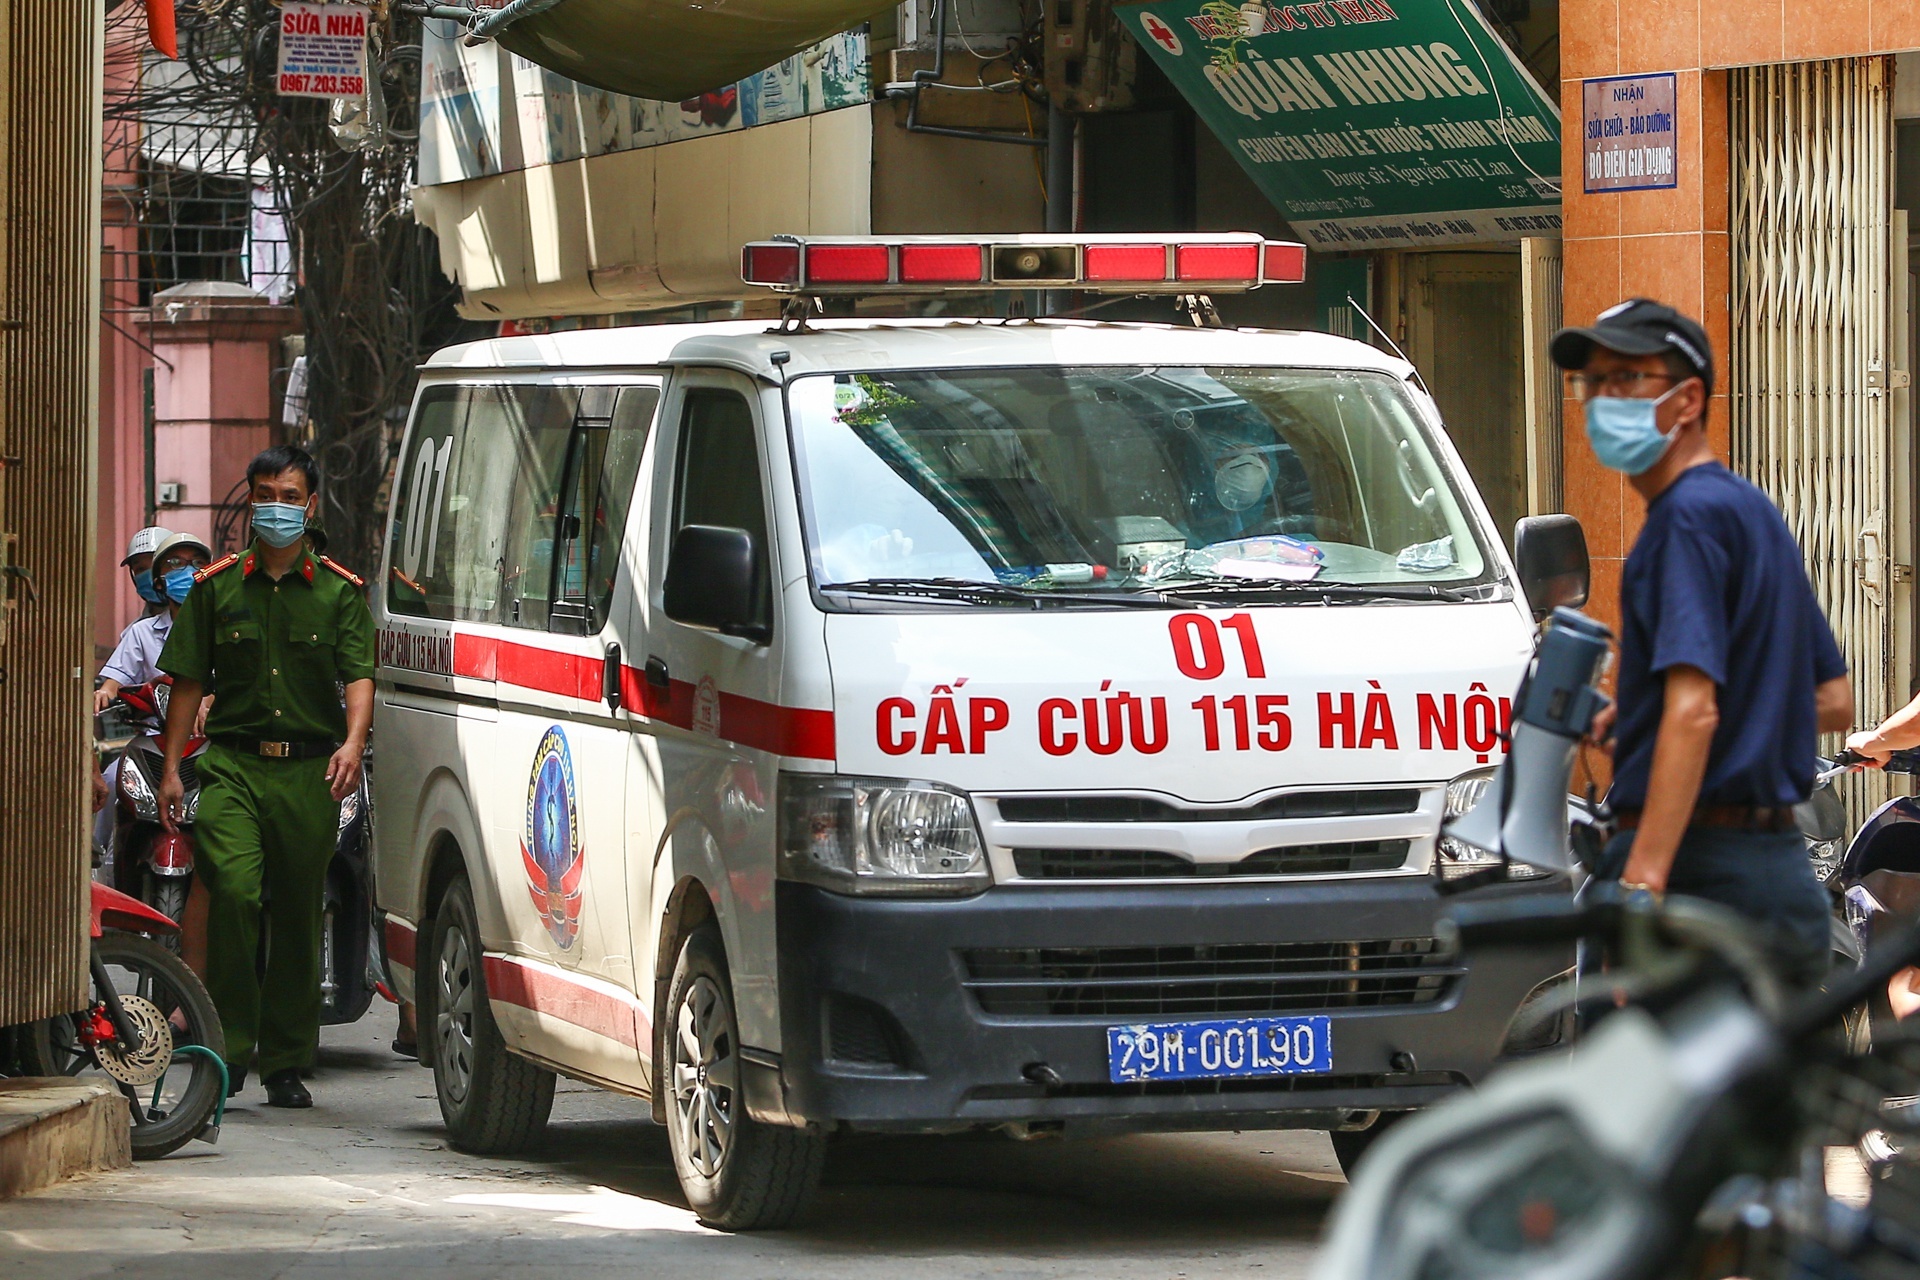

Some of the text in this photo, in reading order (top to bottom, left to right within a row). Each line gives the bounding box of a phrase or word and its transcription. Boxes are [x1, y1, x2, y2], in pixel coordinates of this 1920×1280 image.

[283, 7, 365, 36] SỬA NHÀ
[280, 74, 363, 95] 0967.203.558
[1313, 42, 1489, 106] NHUNG
[1613, 84, 1644, 104] NHẬN
[1238, 106, 1554, 163] CHUYÊN BÁN LẺ THUỐC THÀNH PHẨM
[1588, 112, 1602, 139] SỬA
[1604, 113, 1623, 138] CHỮA
[1630, 108, 1644, 135] BẢO
[1646, 109, 1671, 133] DƯỠNG
[1322, 168, 1370, 190] Dược
[1384, 157, 1450, 187] Nguyễn
[1442, 158, 1485, 182] Thị
[1473, 158, 1514, 176] Lan
[1604, 144, 1626, 184] ĐIỆN
[1628, 149, 1644, 177] GIA
[1646, 146, 1672, 182] DỤNG
[1498, 184, 1516, 199] Số
[1319, 221, 1348, 243] 134
[403, 435, 454, 582] 01
[381, 619, 452, 682] CẤP CỨU 115 HÀ NỘI
[1168, 613, 1266, 681] 01
[875, 677, 1512, 764] CẤP CỨU 115 HÀ NỘI
